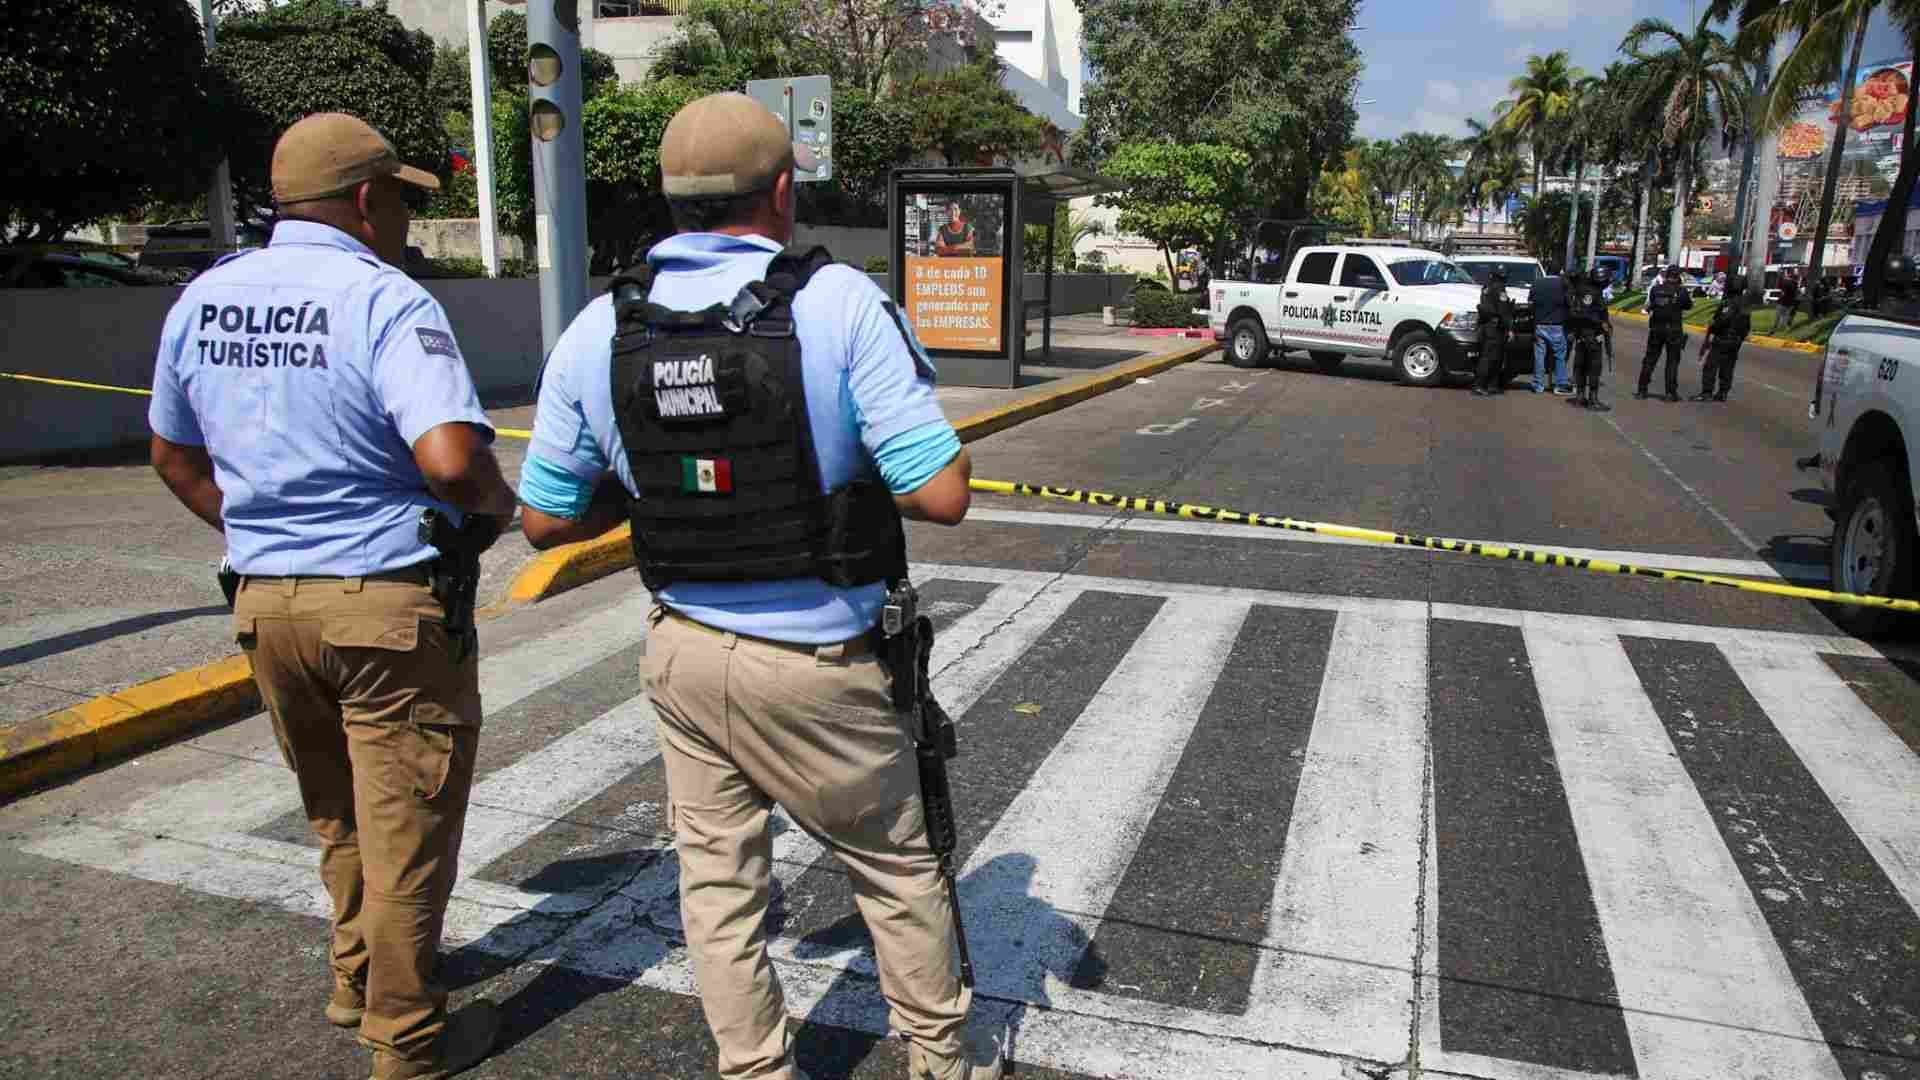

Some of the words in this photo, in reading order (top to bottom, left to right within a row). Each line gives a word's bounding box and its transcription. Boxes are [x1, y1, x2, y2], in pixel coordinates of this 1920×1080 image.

[927, 265, 940, 279] de
[944, 265, 970, 280] cada
[975, 265, 987, 279] 10
[916, 282, 965, 296] EMPLEOS
[200, 301, 329, 336] POLICÍA
[916, 298, 969, 312] generados
[971, 301, 991, 313] por
[1339, 309, 1382, 325] ESTATAL
[198, 337, 328, 369] TURÍSTICA
[654, 354, 715, 388] POLICÍA
[1877, 356, 1899, 382] 620
[655, 386, 722, 416] MUNICIPAL
